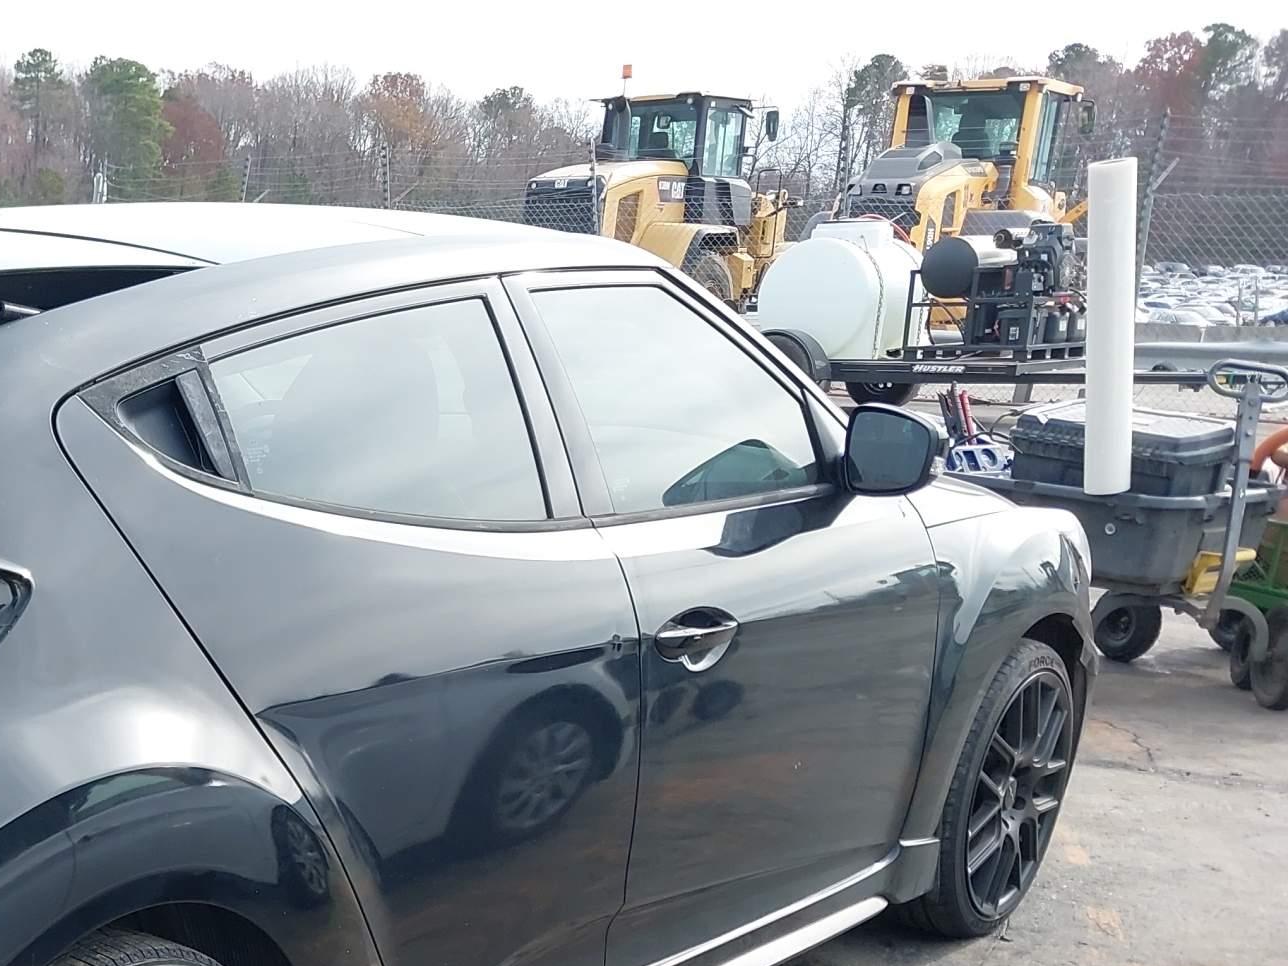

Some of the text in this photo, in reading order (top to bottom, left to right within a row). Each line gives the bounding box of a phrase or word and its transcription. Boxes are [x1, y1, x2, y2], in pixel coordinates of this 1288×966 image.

[554, 179, 568, 189] CAT
[671, 181, 686, 199] CAT
[912, 364, 966, 373] HUSTLER
